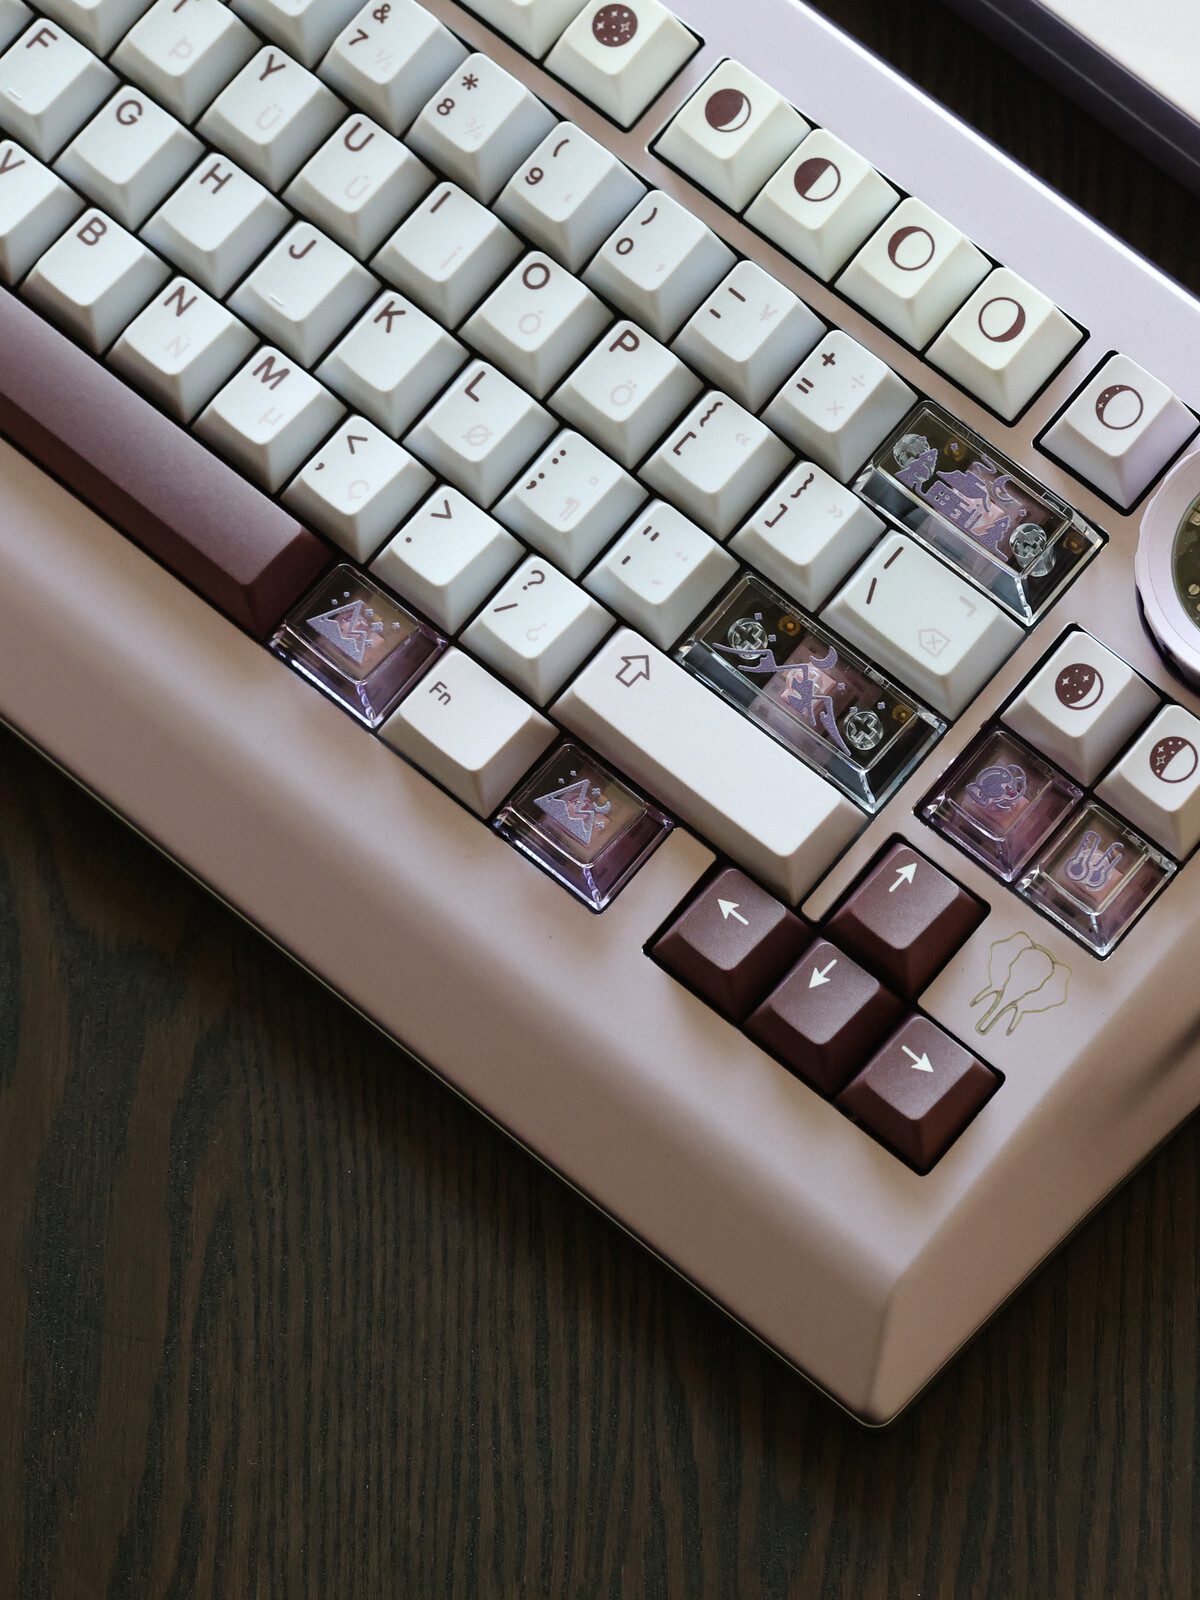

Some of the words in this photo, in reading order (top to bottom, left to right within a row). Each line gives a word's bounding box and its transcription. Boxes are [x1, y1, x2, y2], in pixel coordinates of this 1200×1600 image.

[372, 3, 390, 24] &
[26, 28, 58, 48] F
[349, 29, 369, 45] 7
[259, 54, 286, 81] Y
[116, 100, 143, 125] G
[437, 98, 455, 116] 8
[344, 122, 374, 152] U
[0, 149, 25, 174] V
[200, 163, 233, 194] H
[525, 167, 544, 185] 9
[430, 191, 451, 213] I
[77, 217, 107, 246] B
[289, 240, 317, 259] J
[522, 263, 550, 290] O
[164, 285, 197, 317] N
[374, 301, 406, 333] K
[609, 329, 640, 352] P
[822, 353, 835, 366] +
[252, 356, 290, 390] M
[465, 371, 486, 402] L
[347, 435, 368, 454] <
[673, 431, 697, 456] [
[431, 500, 452, 519] >
[764, 503, 788, 528] ]
[523, 570, 545, 590] ?
[429, 681, 451, 705] Fn
